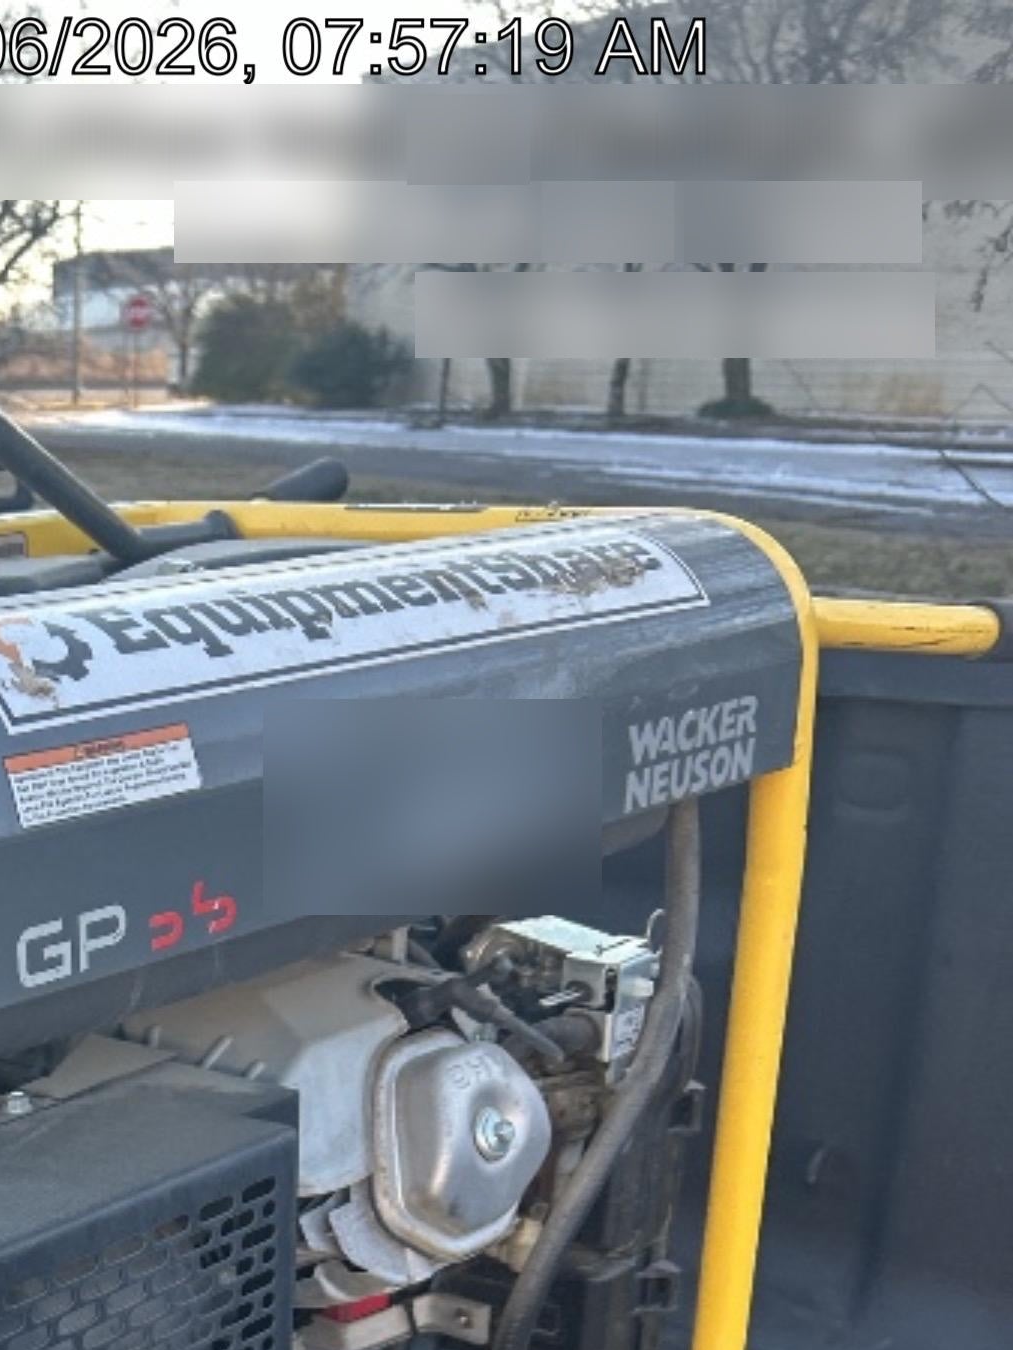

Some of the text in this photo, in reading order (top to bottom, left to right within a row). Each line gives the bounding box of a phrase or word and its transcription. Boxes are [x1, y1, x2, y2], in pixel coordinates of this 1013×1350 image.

[628, 695, 759, 766] WACKER
[623, 737, 756, 815] NEUSON
[16, 904, 127, 988] GP
